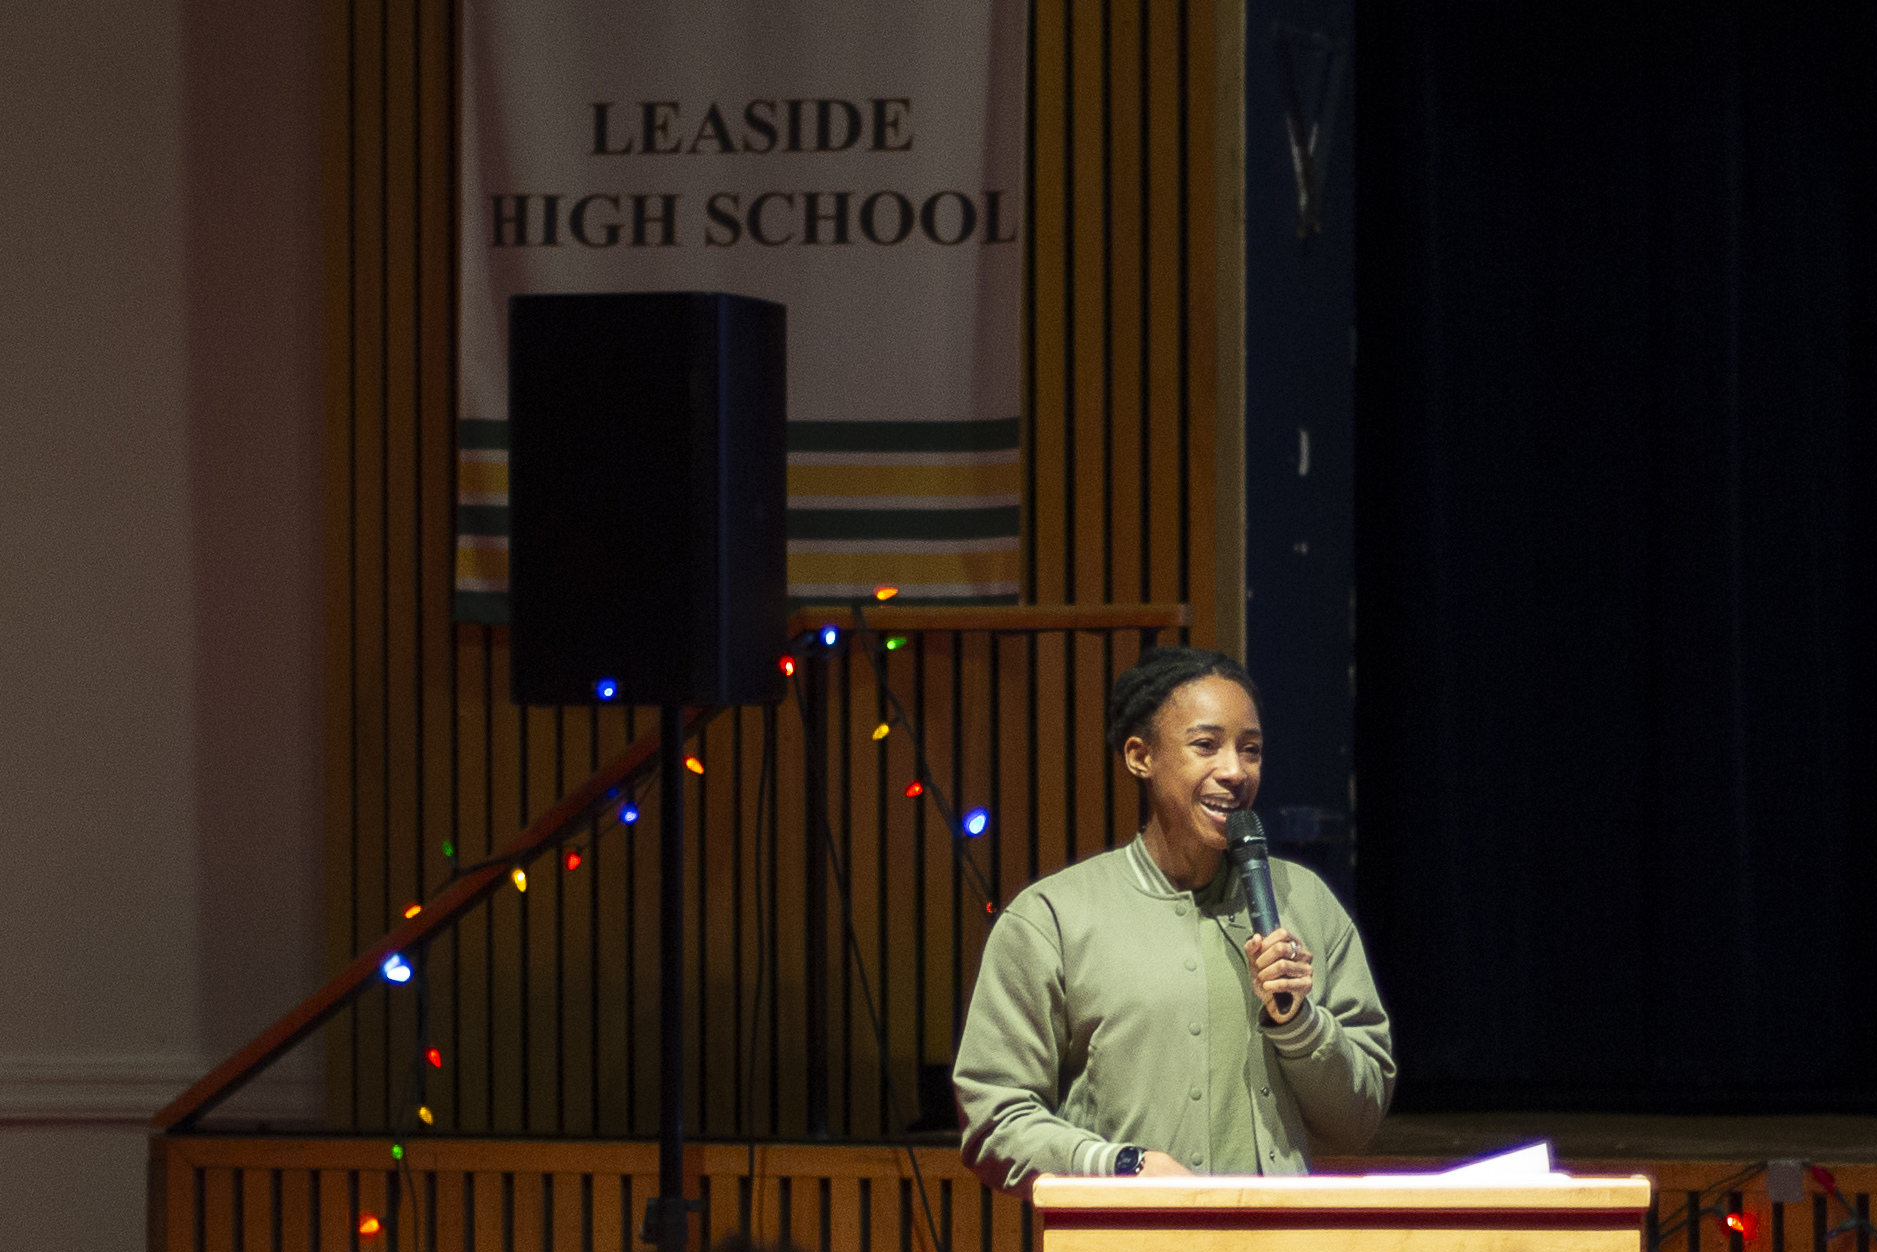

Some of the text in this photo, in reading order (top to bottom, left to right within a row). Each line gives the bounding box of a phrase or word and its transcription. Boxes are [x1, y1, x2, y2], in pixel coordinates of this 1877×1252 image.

[590, 97, 915, 156] LEASIDE
[490, 189, 1018, 248] HIGH SCHOOL
